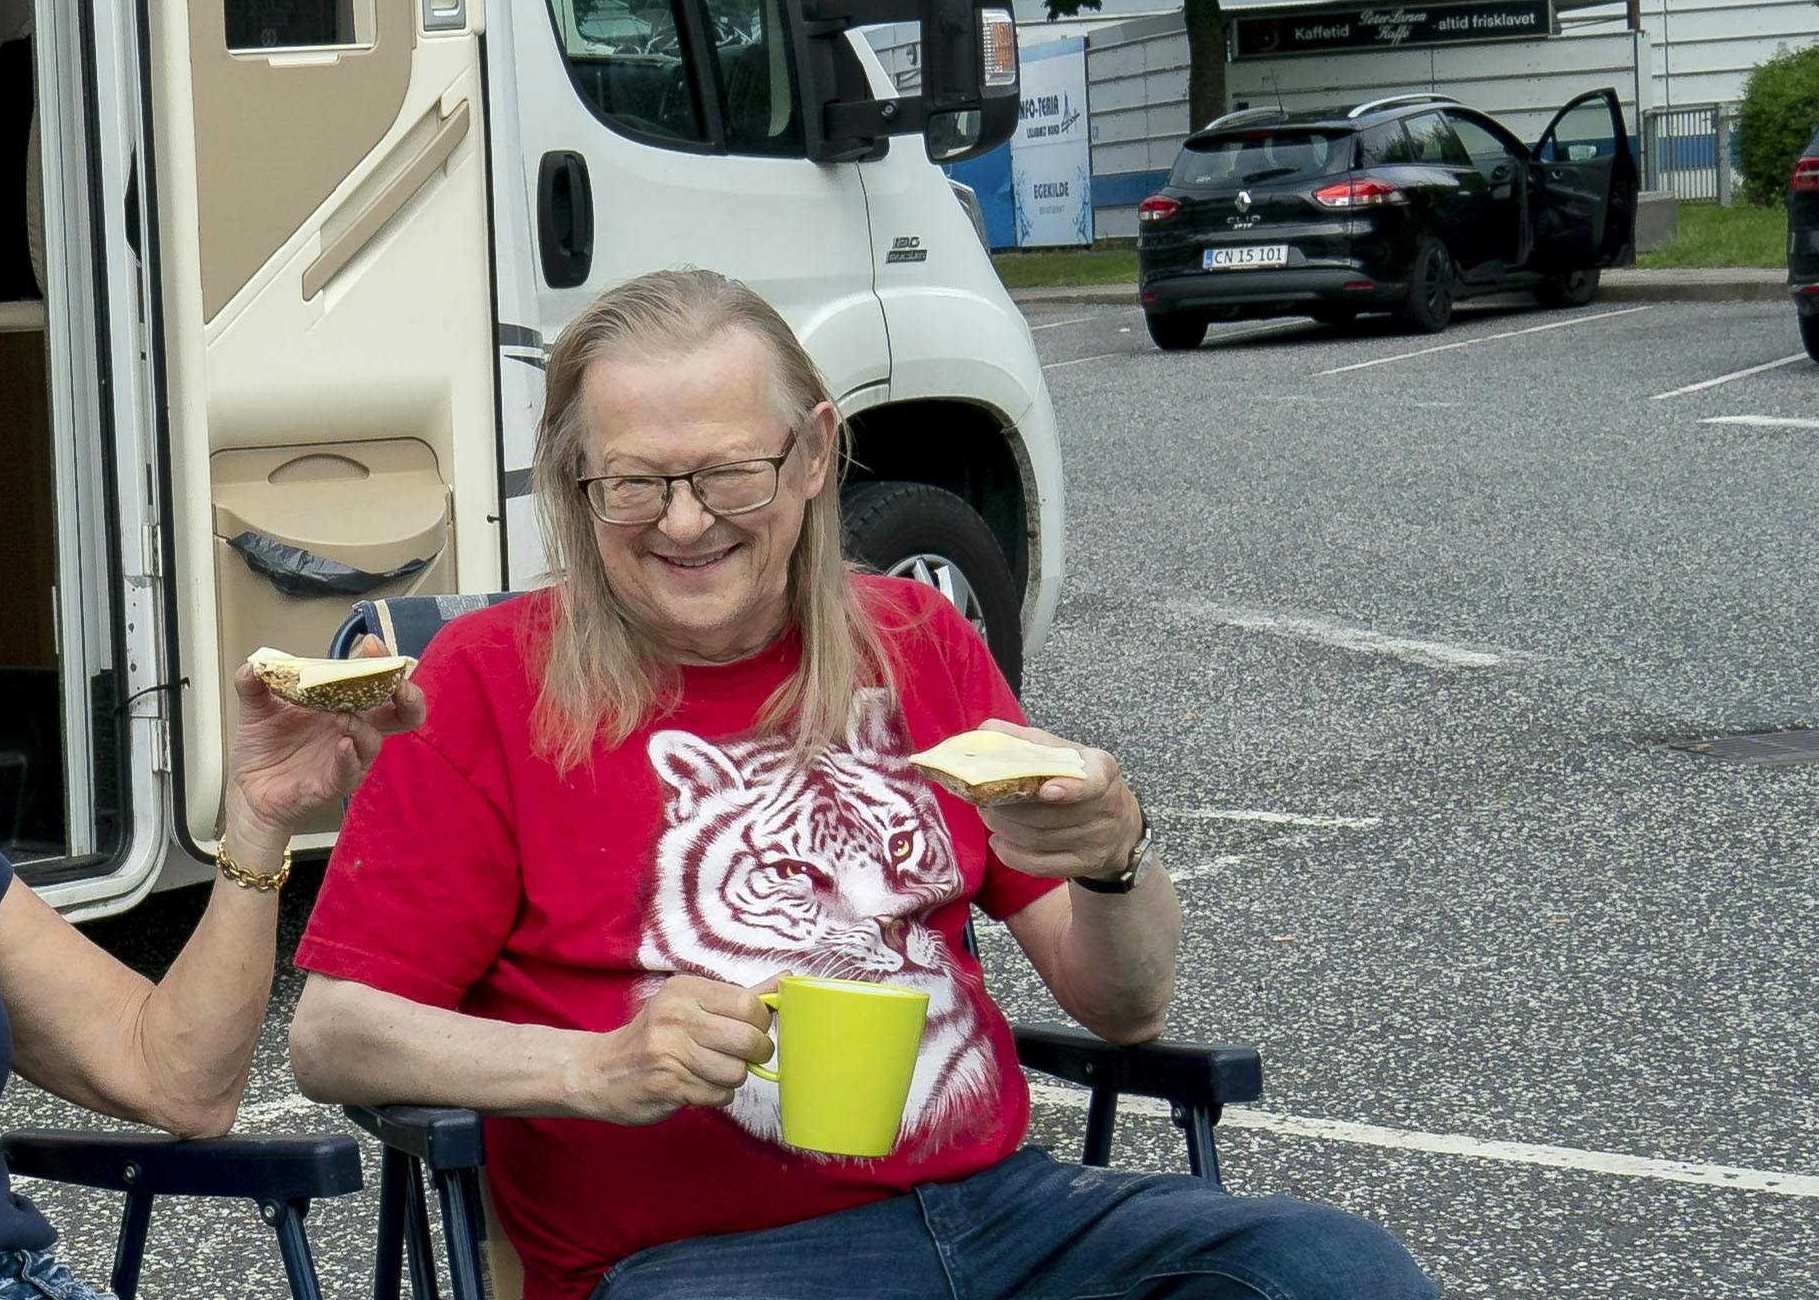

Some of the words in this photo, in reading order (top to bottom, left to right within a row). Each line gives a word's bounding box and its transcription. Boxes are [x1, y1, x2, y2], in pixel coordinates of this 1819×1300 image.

[1357, 9, 1391, 26] Peter
[1388, 7, 1428, 24] Larsen
[1438, 14, 1469, 31] altid
[1472, 12, 1535, 28] frisklavet
[1294, 24, 1350, 41] Kaffetid
[1019, 94, 1060, 120] NFO-TERIA
[1033, 181, 1070, 200] EGEKILDE
[1214, 250, 1234, 264] CN
[1239, 248, 1254, 263] 15
[1259, 247, 1282, 261] 101
